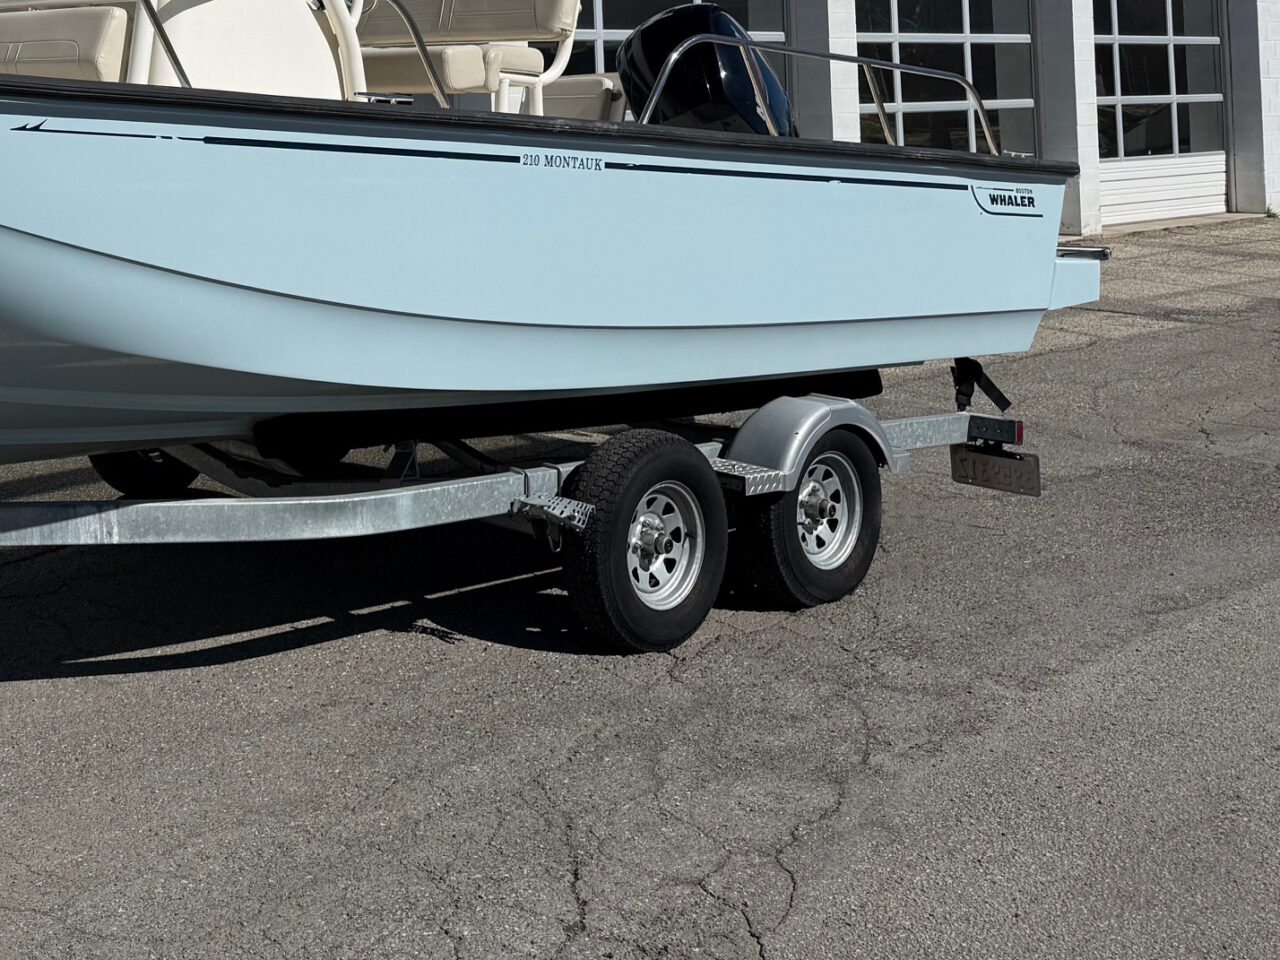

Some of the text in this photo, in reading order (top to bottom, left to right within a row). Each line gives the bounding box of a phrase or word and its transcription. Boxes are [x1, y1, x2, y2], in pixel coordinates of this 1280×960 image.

[523, 153, 603, 171] 210 MONTAUK
[989, 194, 1036, 208] WHALER
